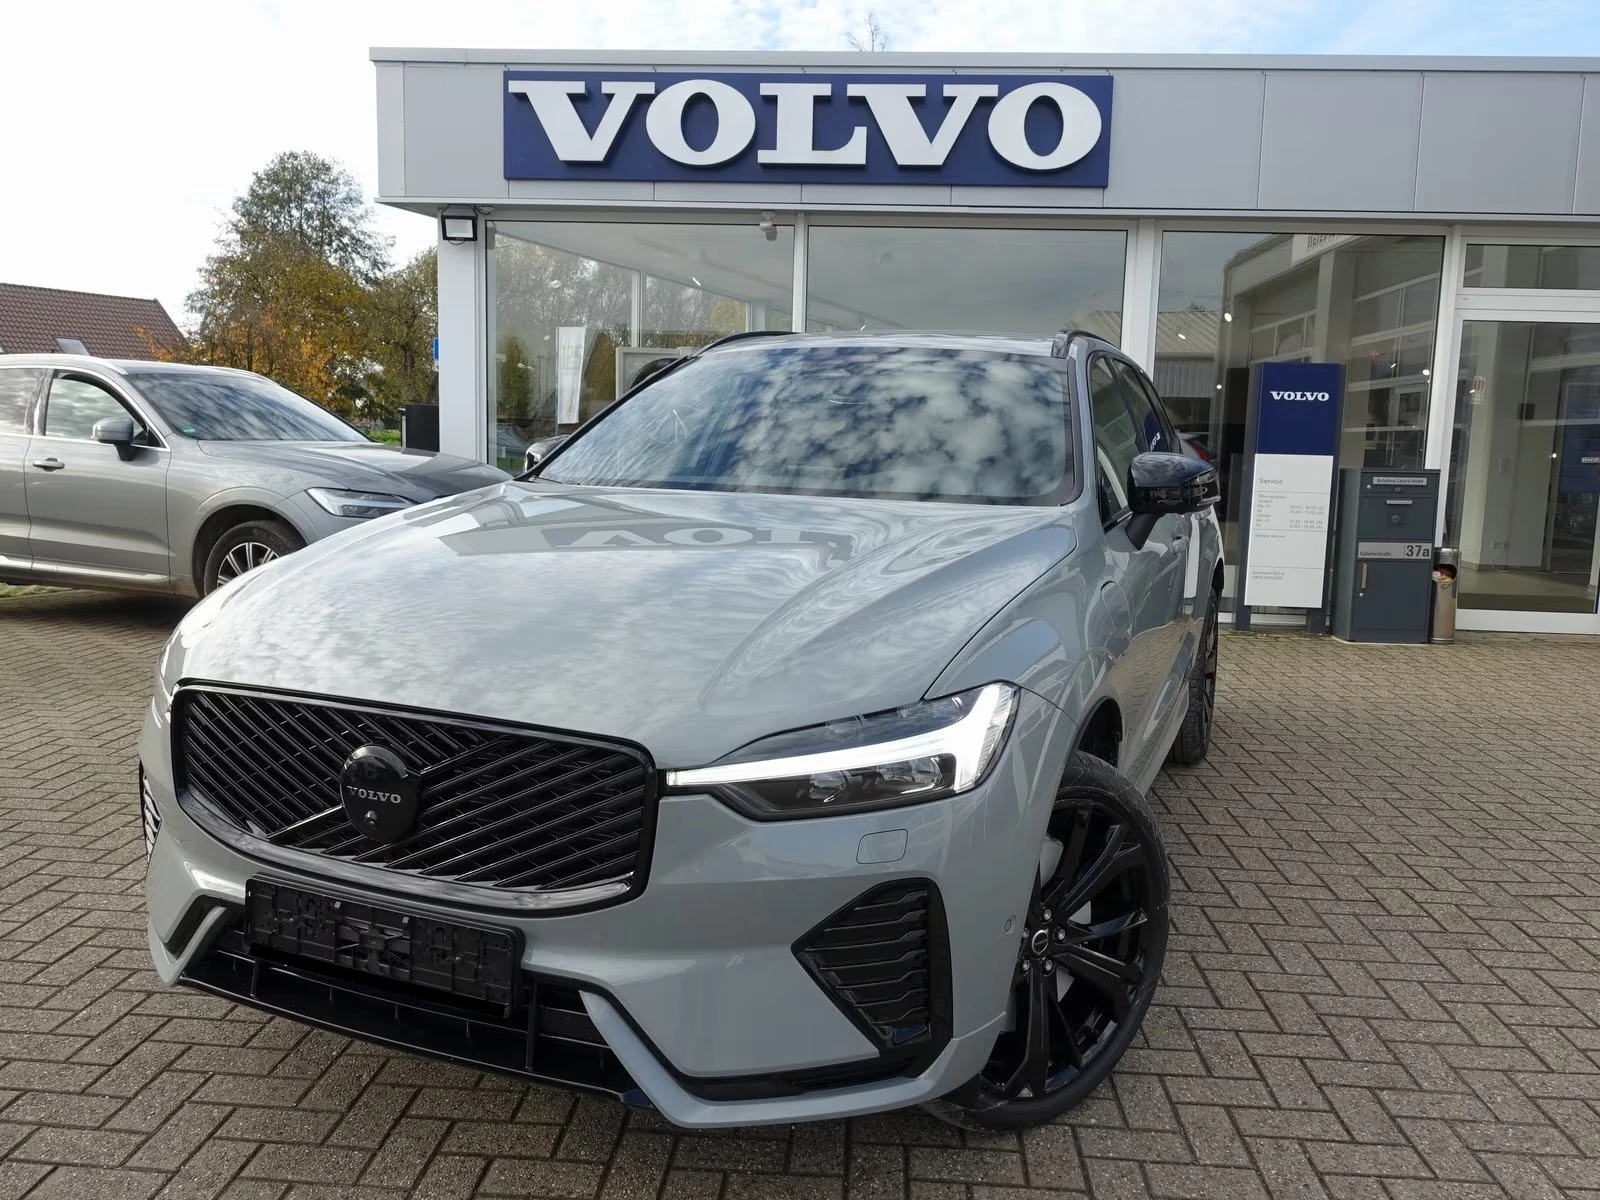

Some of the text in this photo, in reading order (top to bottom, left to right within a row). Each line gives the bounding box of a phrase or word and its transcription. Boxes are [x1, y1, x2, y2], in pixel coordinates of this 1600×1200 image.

[508, 79, 1102, 170] VOLVO
[1270, 390, 1330, 402] VOLVO
[1259, 477, 1283, 485] Service
[1406, 545, 1430, 557] 37a
[346, 785, 402, 804] VOLVO
